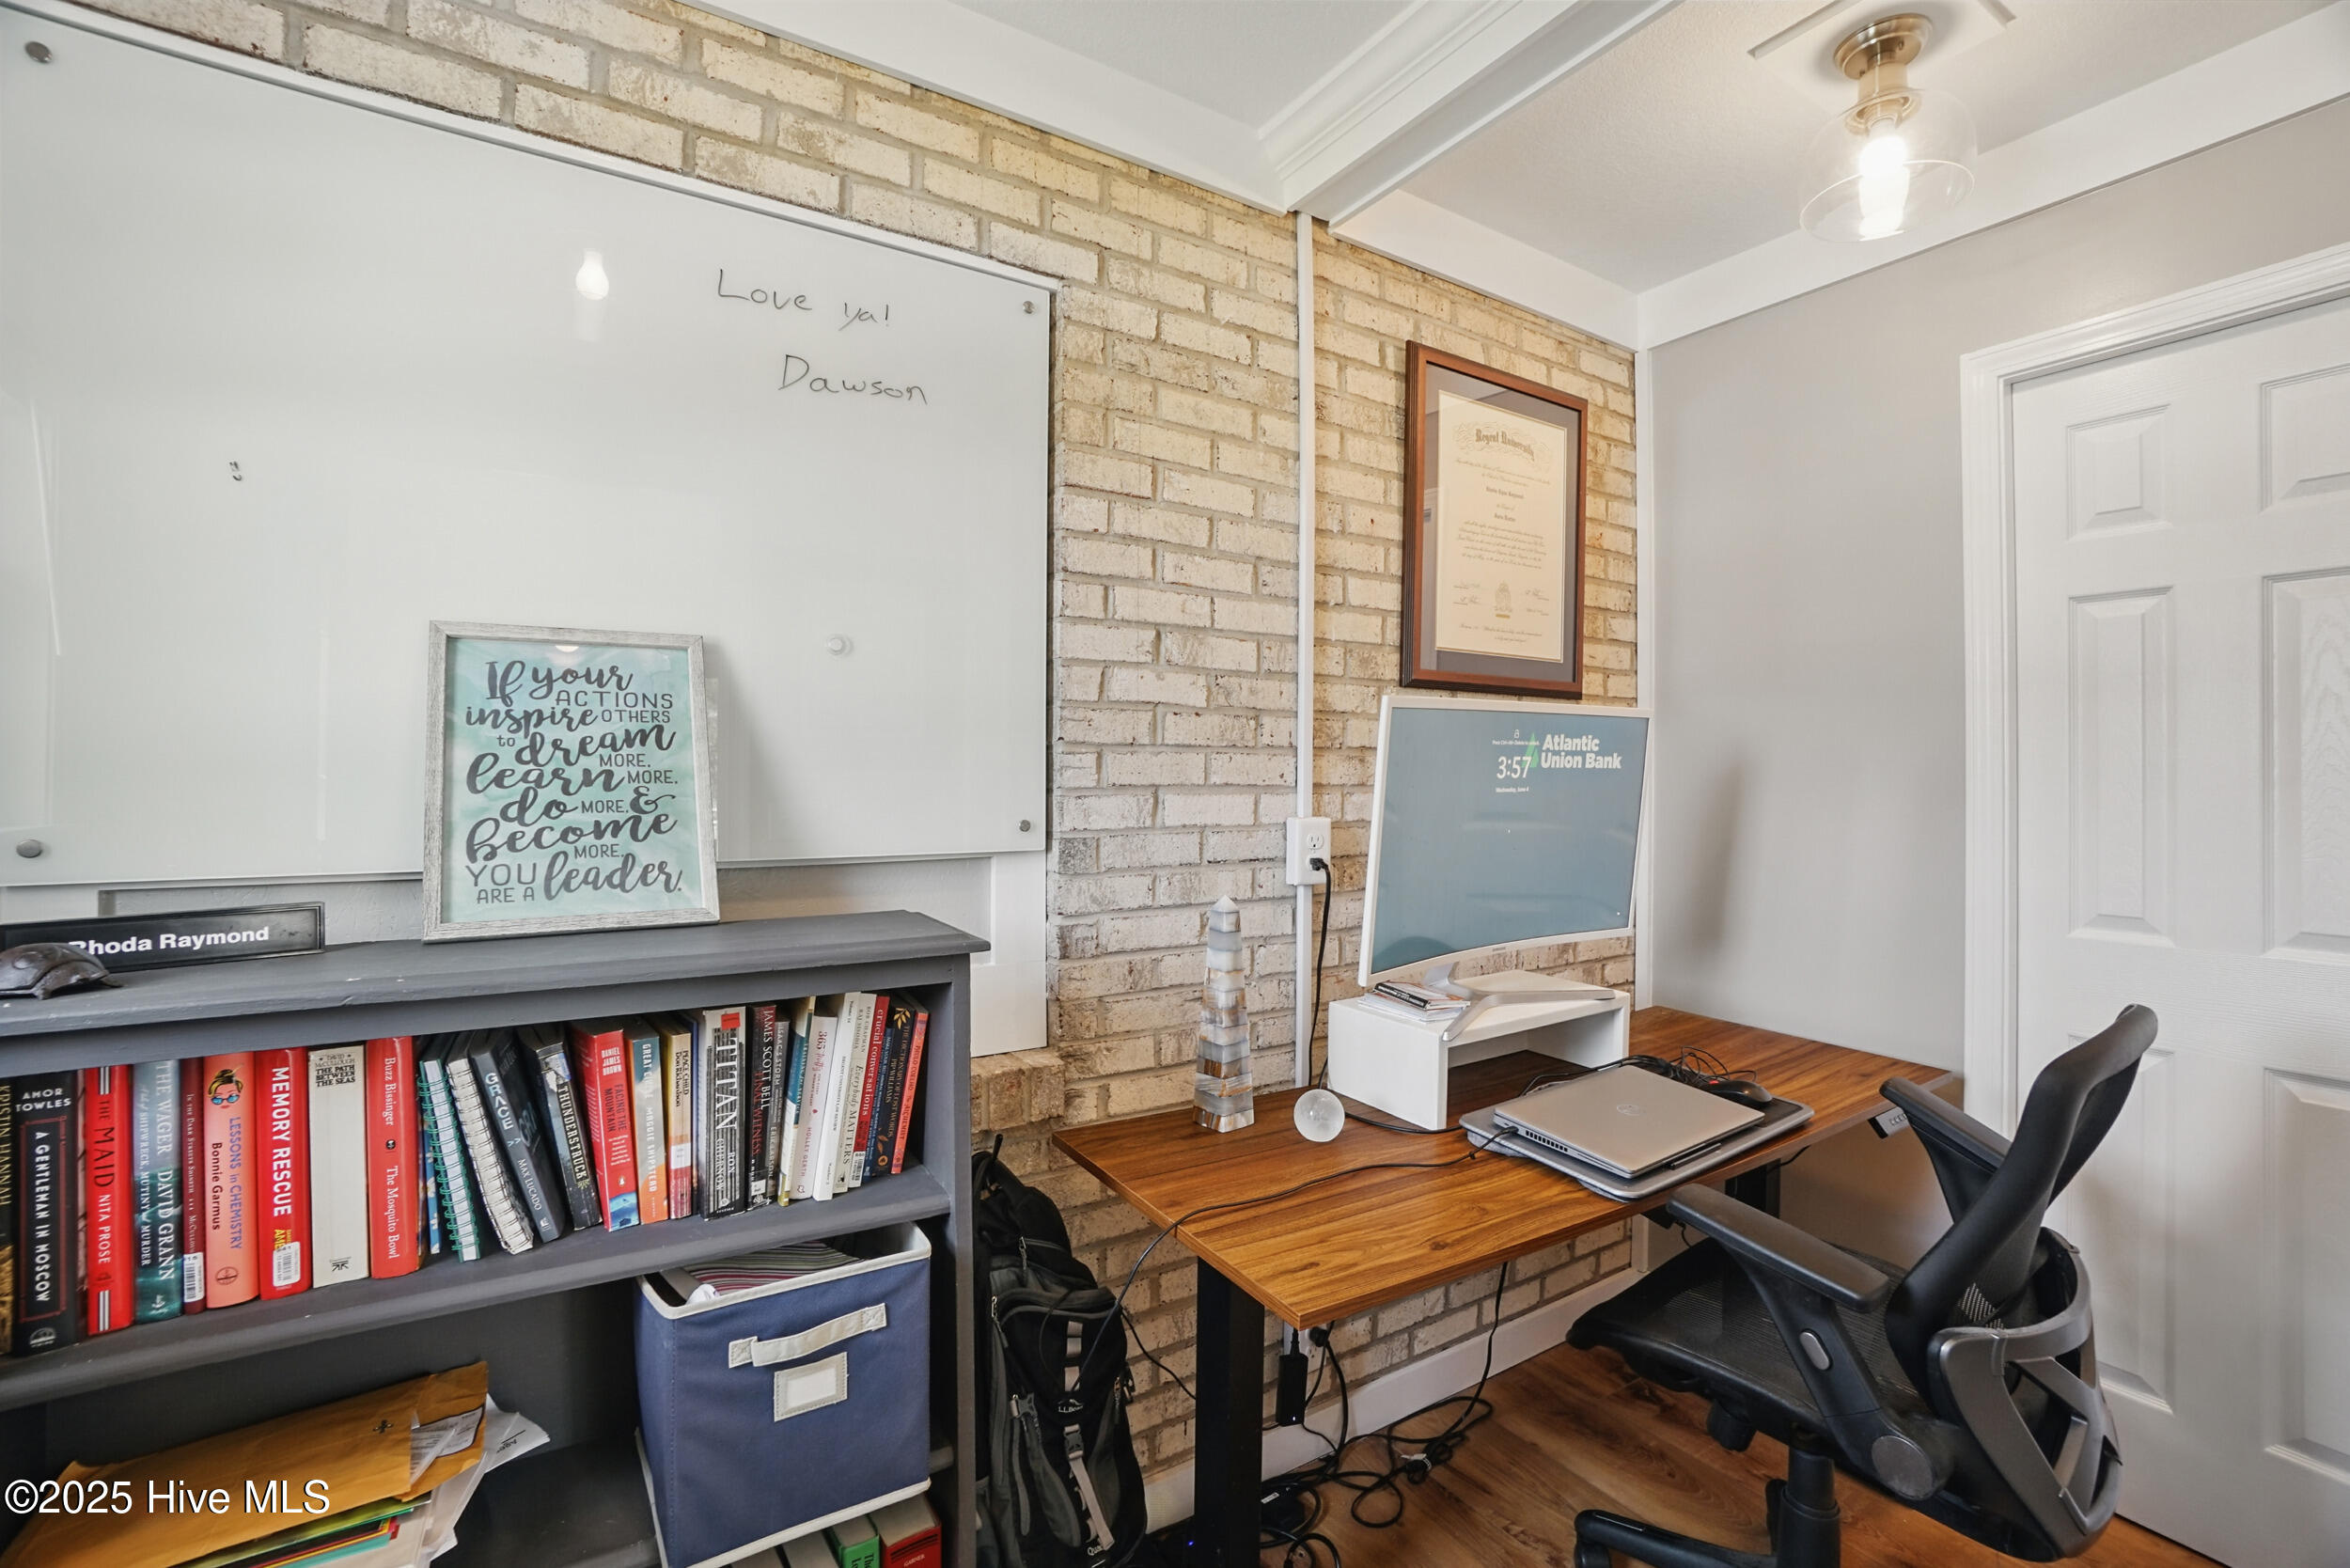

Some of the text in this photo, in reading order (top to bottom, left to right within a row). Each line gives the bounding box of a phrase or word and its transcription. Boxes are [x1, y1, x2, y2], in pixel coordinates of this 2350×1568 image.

[718, 269, 889, 331] Love ya!
[777, 354, 928, 404] Dawson
[486, 660, 634, 707] If your
[555, 690, 673, 709] ACTIONS
[465, 705, 671, 739] inspire OTHERS
[1543, 733, 1600, 751] Atlantic
[496, 724, 677, 767] to dream
[599, 753, 650, 768] MORE.
[1541, 752, 1622, 769] Union Bank
[466, 752, 679, 796] learn MORE.
[1496, 756, 1531, 778] 3:57
[499, 785, 677, 827] do MORE. &
[465, 812, 679, 864] become
[574, 843, 625, 859] MORE.
[465, 863, 537, 886] YOU
[477, 886, 535, 903] ARE A
[543, 850, 683, 901] leader.
[160, 926, 269, 951] Raymond
[816, 1031, 827, 1050] 365
[872, 1009, 884, 1044] crucial
[335, 1064, 354, 1073] PATH
[602, 1047, 620, 1058] DANIEL
[603, 1057, 621, 1067] JAMES
[603, 1066, 622, 1076] BROWN
[642, 1043, 652, 1069] GREAT
[760, 1010, 775, 1111] JAMES SCOTT BELL
[897, 1039, 908, 1080] DICTIONARY
[23, 1088, 63, 1100] AMOR
[316, 1072, 354, 1080] BETWEEN
[336, 1076, 355, 1085] SEAS
[384, 1058, 397, 1125] Buzz Bissinger
[715, 1038, 738, 1130] TITAN
[849, 1065, 864, 1107] Everybody
[862, 1045, 878, 1116] conversations
[908, 1066, 917, 1090] COELHO
[15, 1098, 71, 1112] TOWLES
[156, 1061, 173, 1155] THE WAGER
[485, 1073, 514, 1130] GRACE
[604, 1089, 616, 1132] MOUNTAIN
[614, 1084, 625, 1112] FACING
[93, 1100, 115, 1187] THE MAID
[229, 1117, 242, 1169] LESSONS
[272, 1067, 291, 1216] MEMORY RESCUE
[557, 1085, 588, 1181] THUNDERSTRUCK
[618, 1115, 627, 1131] THE
[752, 1108, 763, 1156] WITNESS
[843, 1110, 855, 1165] MATTERS
[35, 1144, 51, 1219] GENTLEMAN
[647, 1145, 658, 1192] SHIPSTEAD
[715, 1138, 727, 1190] CHERNOW
[728, 1152, 736, 1174] RON
[212, 1142, 223, 1231] Bonnie Garmus
[518, 1159, 542, 1211] MAX LUCADO
[35, 1225, 51, 1238] IN
[98, 1194, 112, 1263] NITA PROSE
[158, 1170, 176, 1280] DAVID GRANN
[230, 1185, 242, 1249] CHEMISTRY
[384, 1166, 400, 1259] The Mosquito Bowl
[141, 1225, 150, 1265] MURDER
[35, 1244, 51, 1302] MOSCOW
